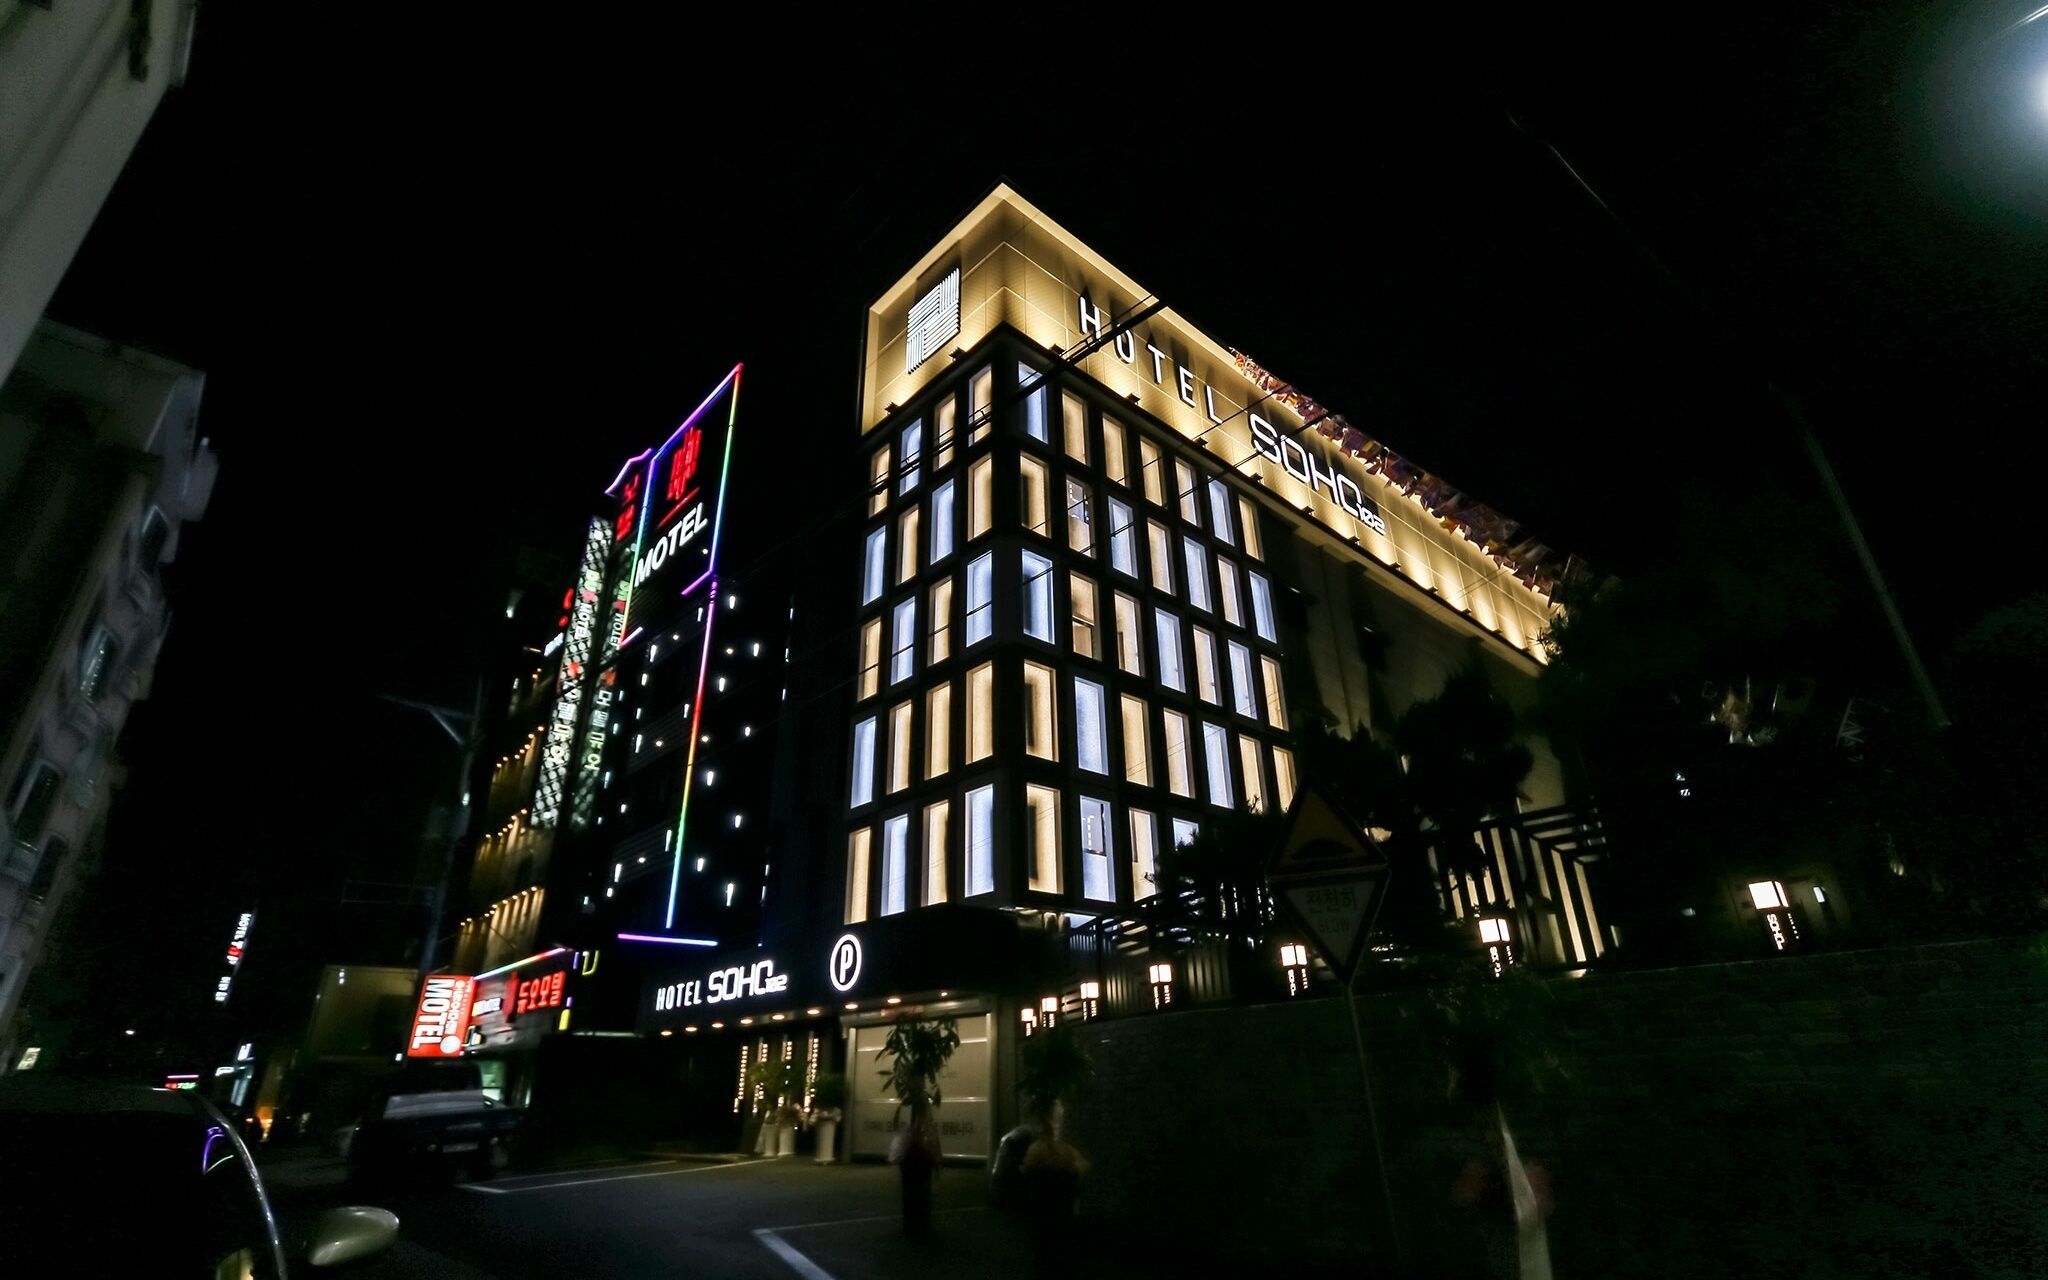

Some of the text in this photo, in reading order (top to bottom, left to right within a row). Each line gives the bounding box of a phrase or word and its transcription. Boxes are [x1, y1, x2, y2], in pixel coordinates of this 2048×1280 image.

[1080, 297, 1223, 424] HOTEL
[634, 502, 709, 587] MOTEL
[412, 979, 456, 1048] MOTEL
[656, 980, 702, 1010] HOTEL
